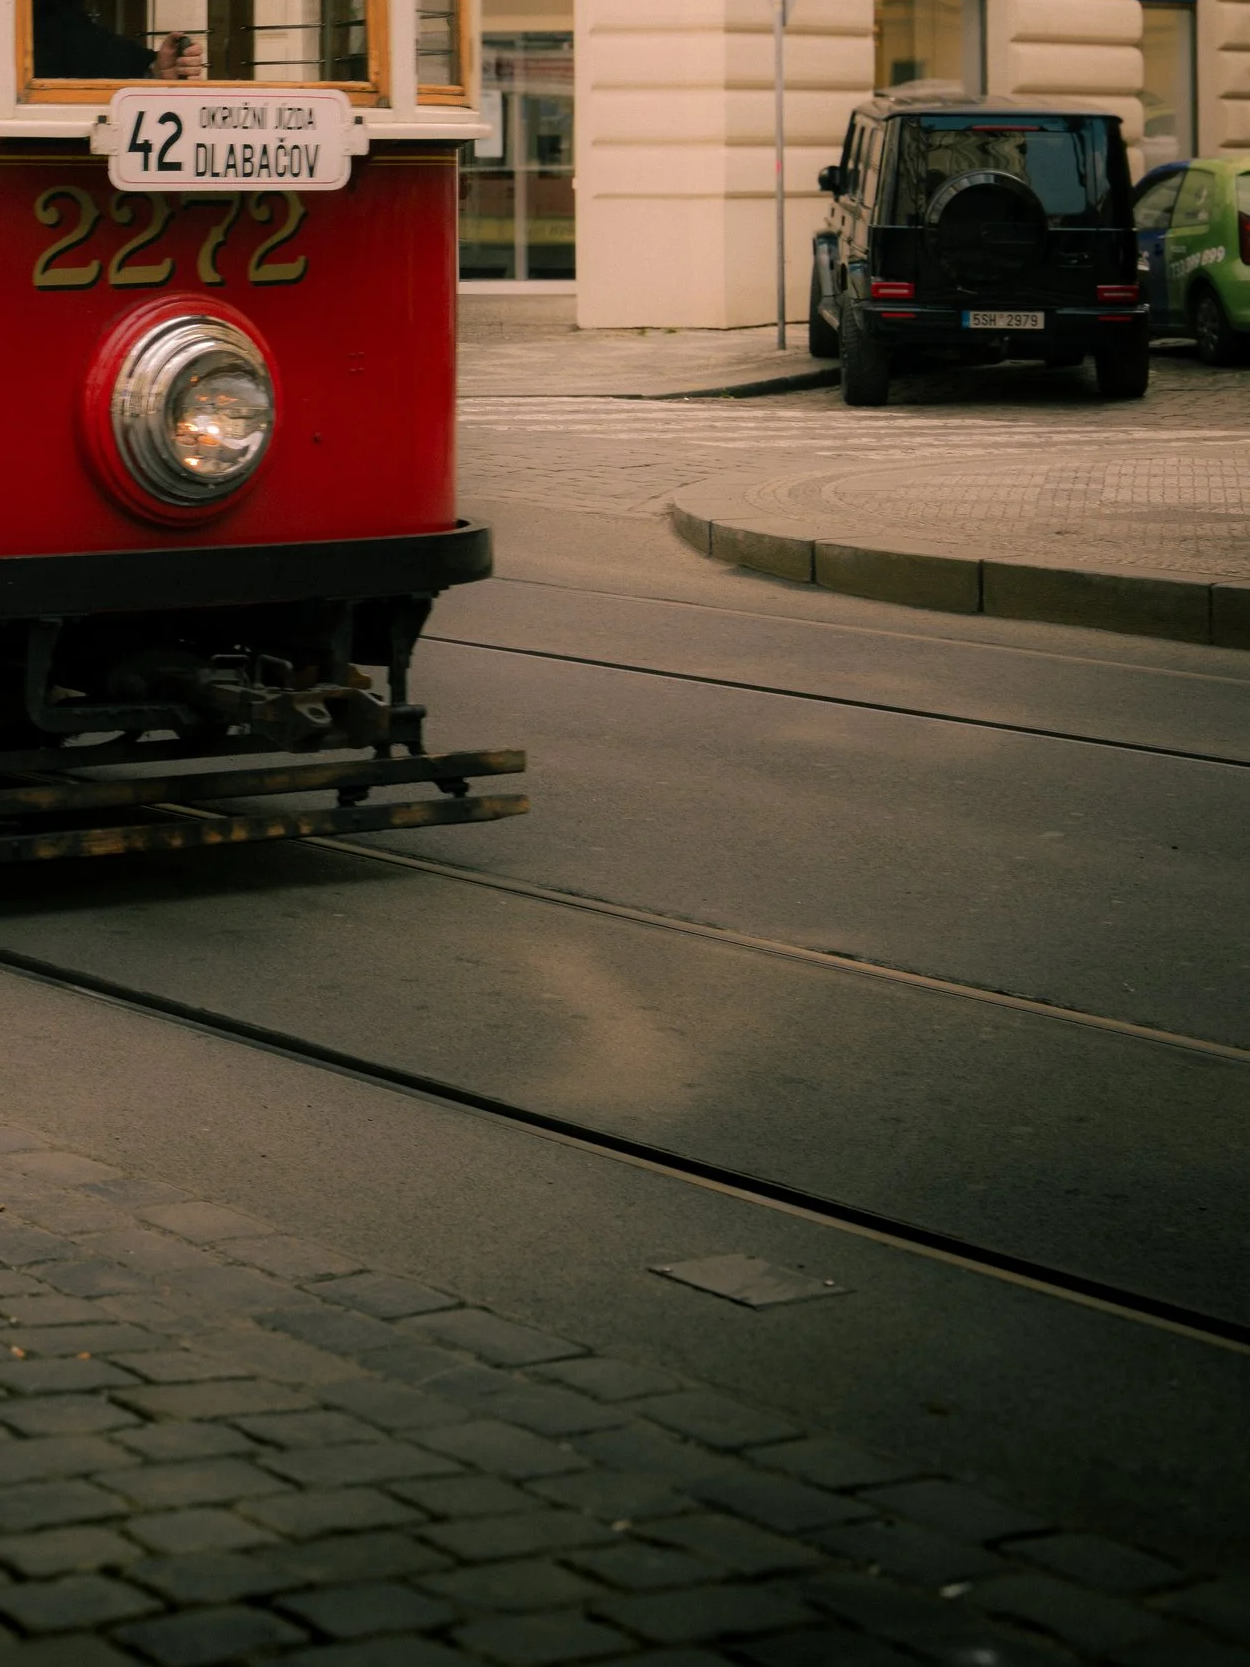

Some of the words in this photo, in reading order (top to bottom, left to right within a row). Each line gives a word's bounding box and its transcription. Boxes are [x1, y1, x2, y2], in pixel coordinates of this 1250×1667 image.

[199, 101, 267, 130] OKRUŽNÍ
[273, 102, 317, 131] JÍZDA
[128, 110, 183, 172] 42
[195, 136, 321, 178] DLABAČOV
[32, 186, 311, 292] 2272
[973, 313, 997, 326] 5SH
[1006, 314, 1038, 327] 2979
